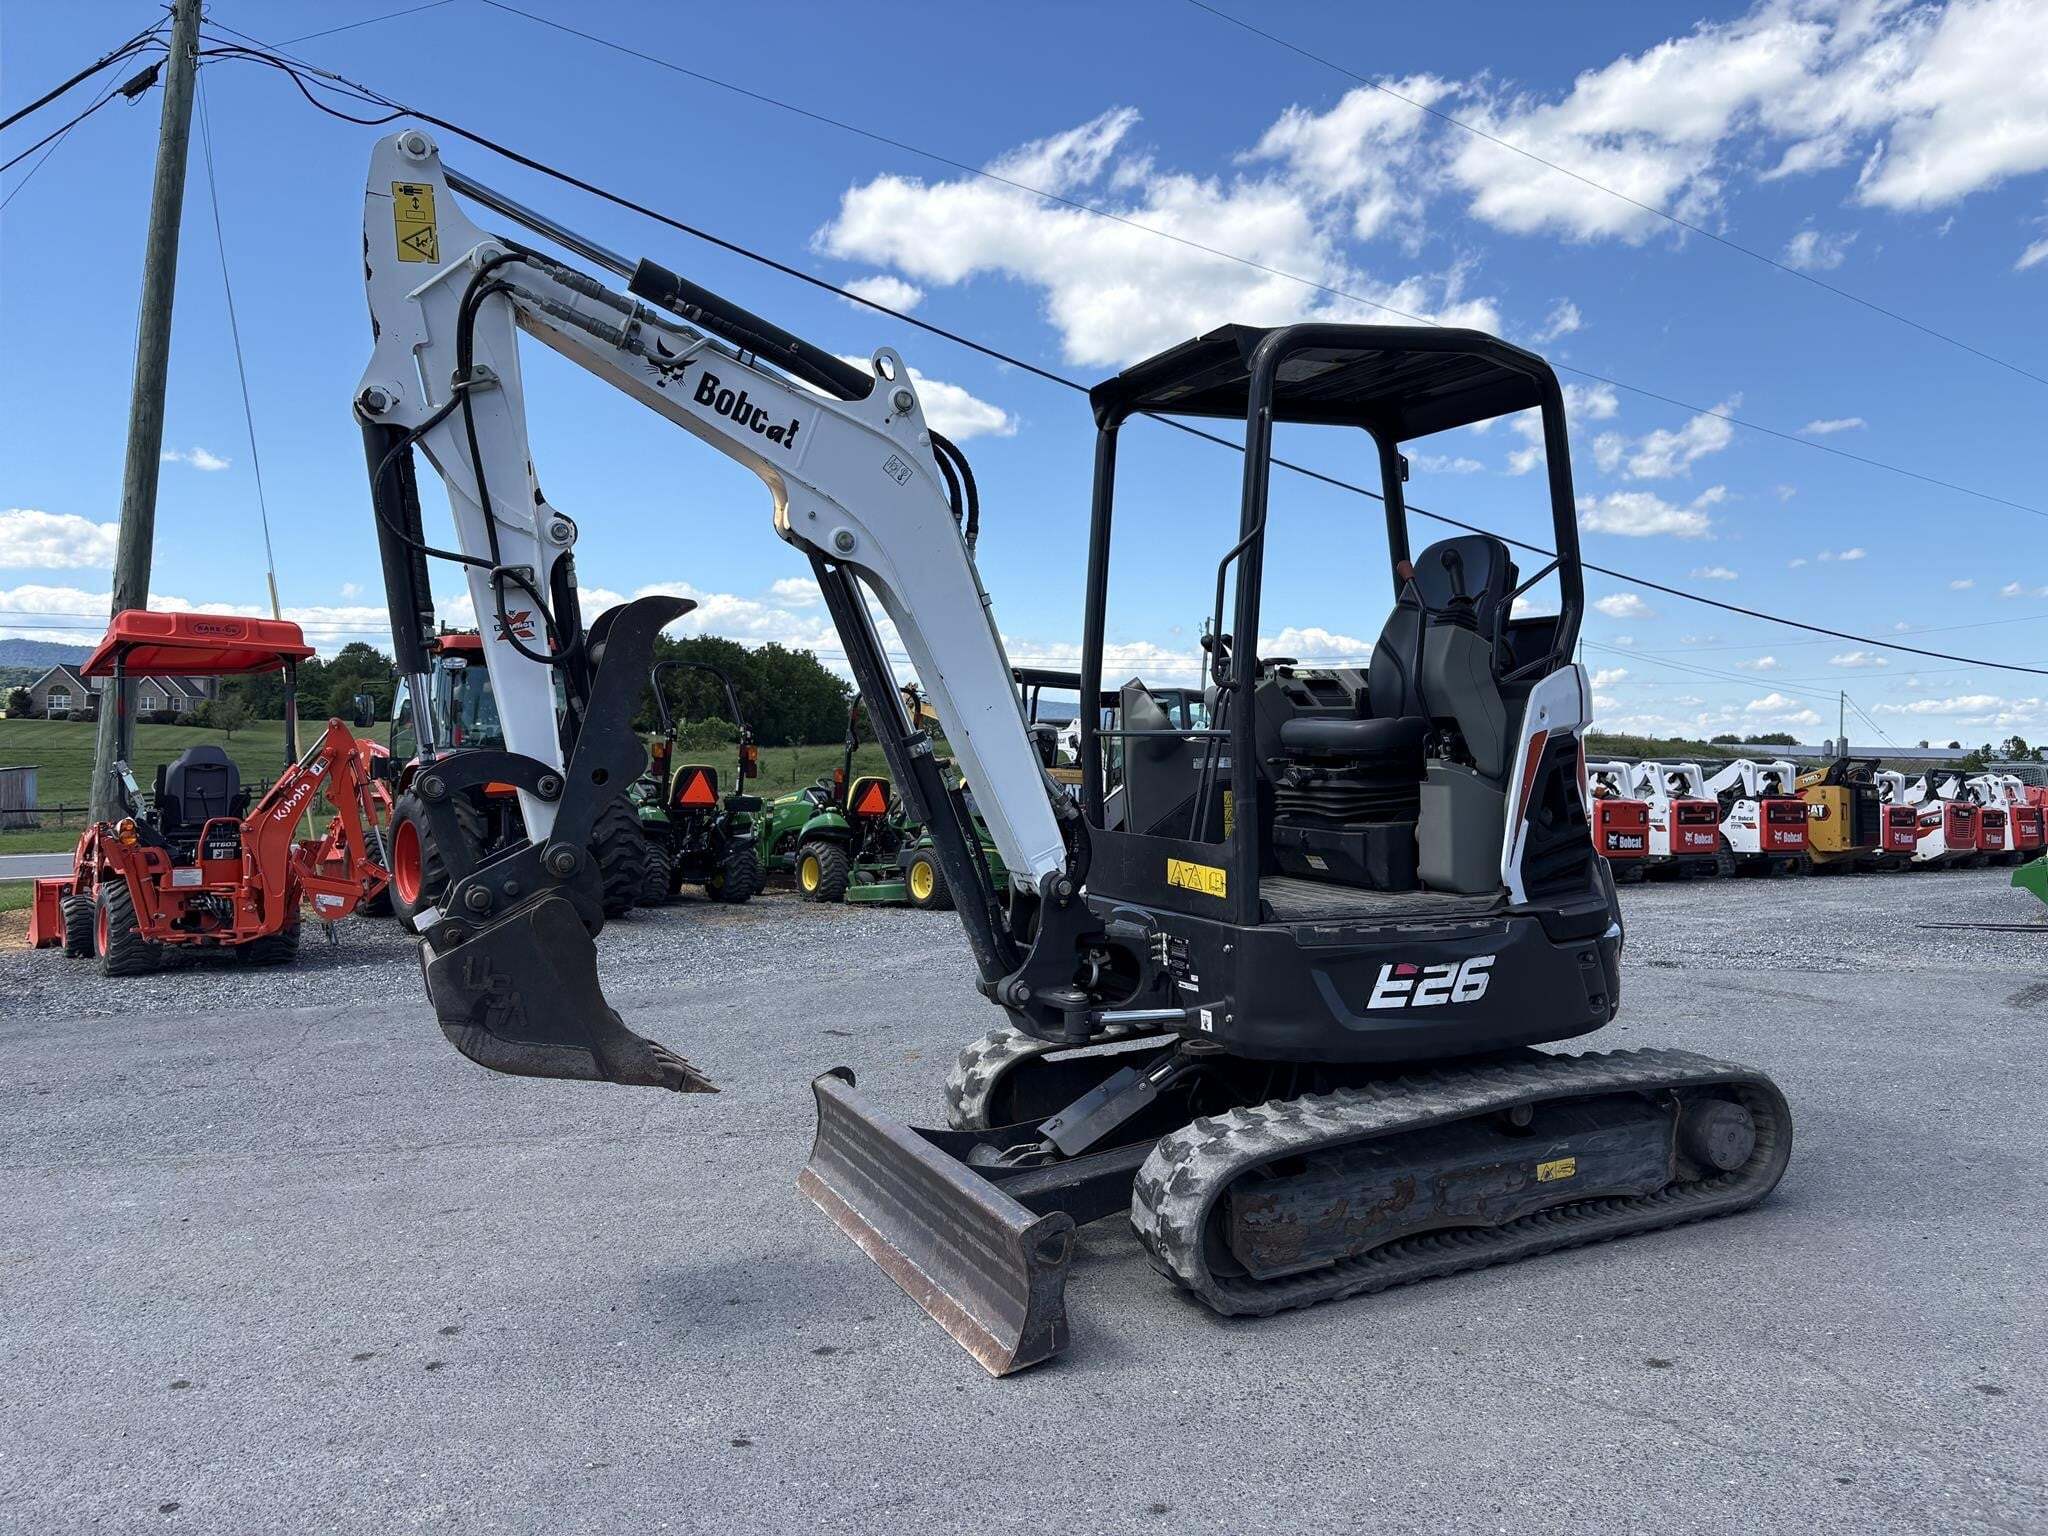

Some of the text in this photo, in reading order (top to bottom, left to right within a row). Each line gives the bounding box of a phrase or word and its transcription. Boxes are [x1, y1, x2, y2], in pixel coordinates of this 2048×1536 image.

[693, 371, 800, 450] Bobcat
[273, 783, 311, 821] Kubota
[1619, 835, 1643, 849] Bobcat
[1693, 833, 1714, 844] Bobcat
[1783, 832, 1803, 843] Bobcat
[1366, 954, 1497, 1010] E26
